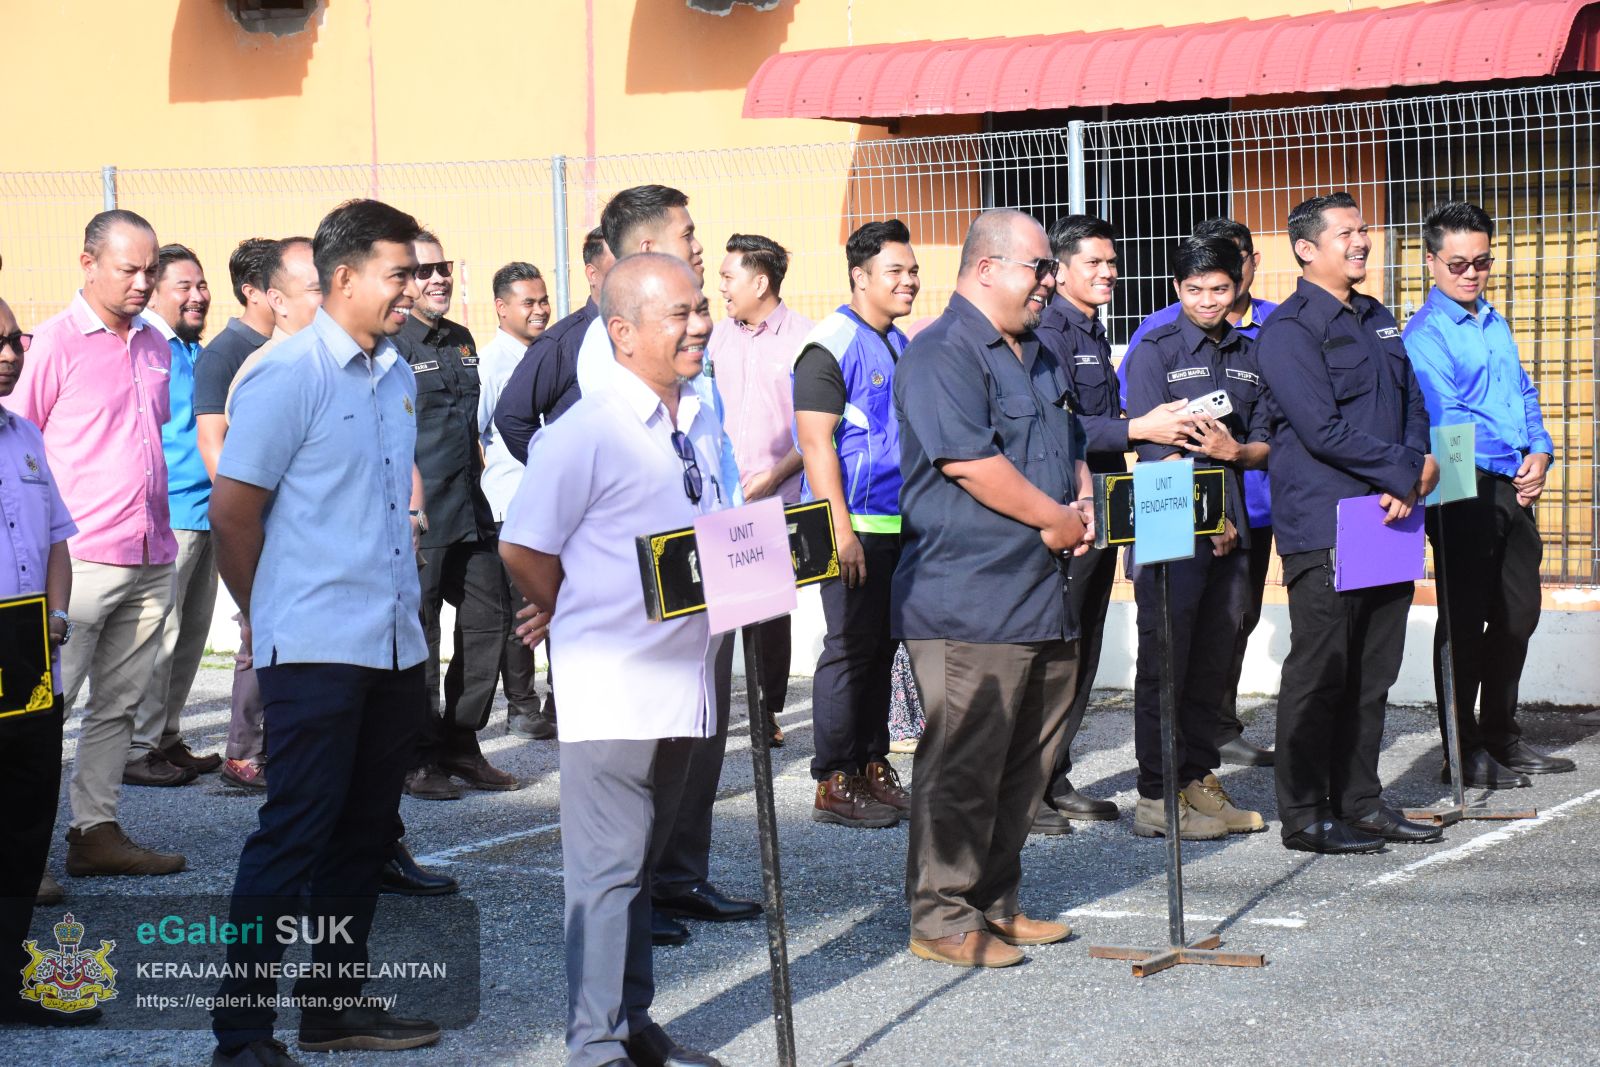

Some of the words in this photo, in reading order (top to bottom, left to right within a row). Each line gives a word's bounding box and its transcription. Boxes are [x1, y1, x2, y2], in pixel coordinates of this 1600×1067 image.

[1450, 435, 1461, 447] UNIT
[1155, 476, 1172, 491] UNIT
[1140, 496, 1188, 514] PENDAFTRAN
[729, 522, 754, 542] UNIT
[727, 546, 765, 569] TANAH
